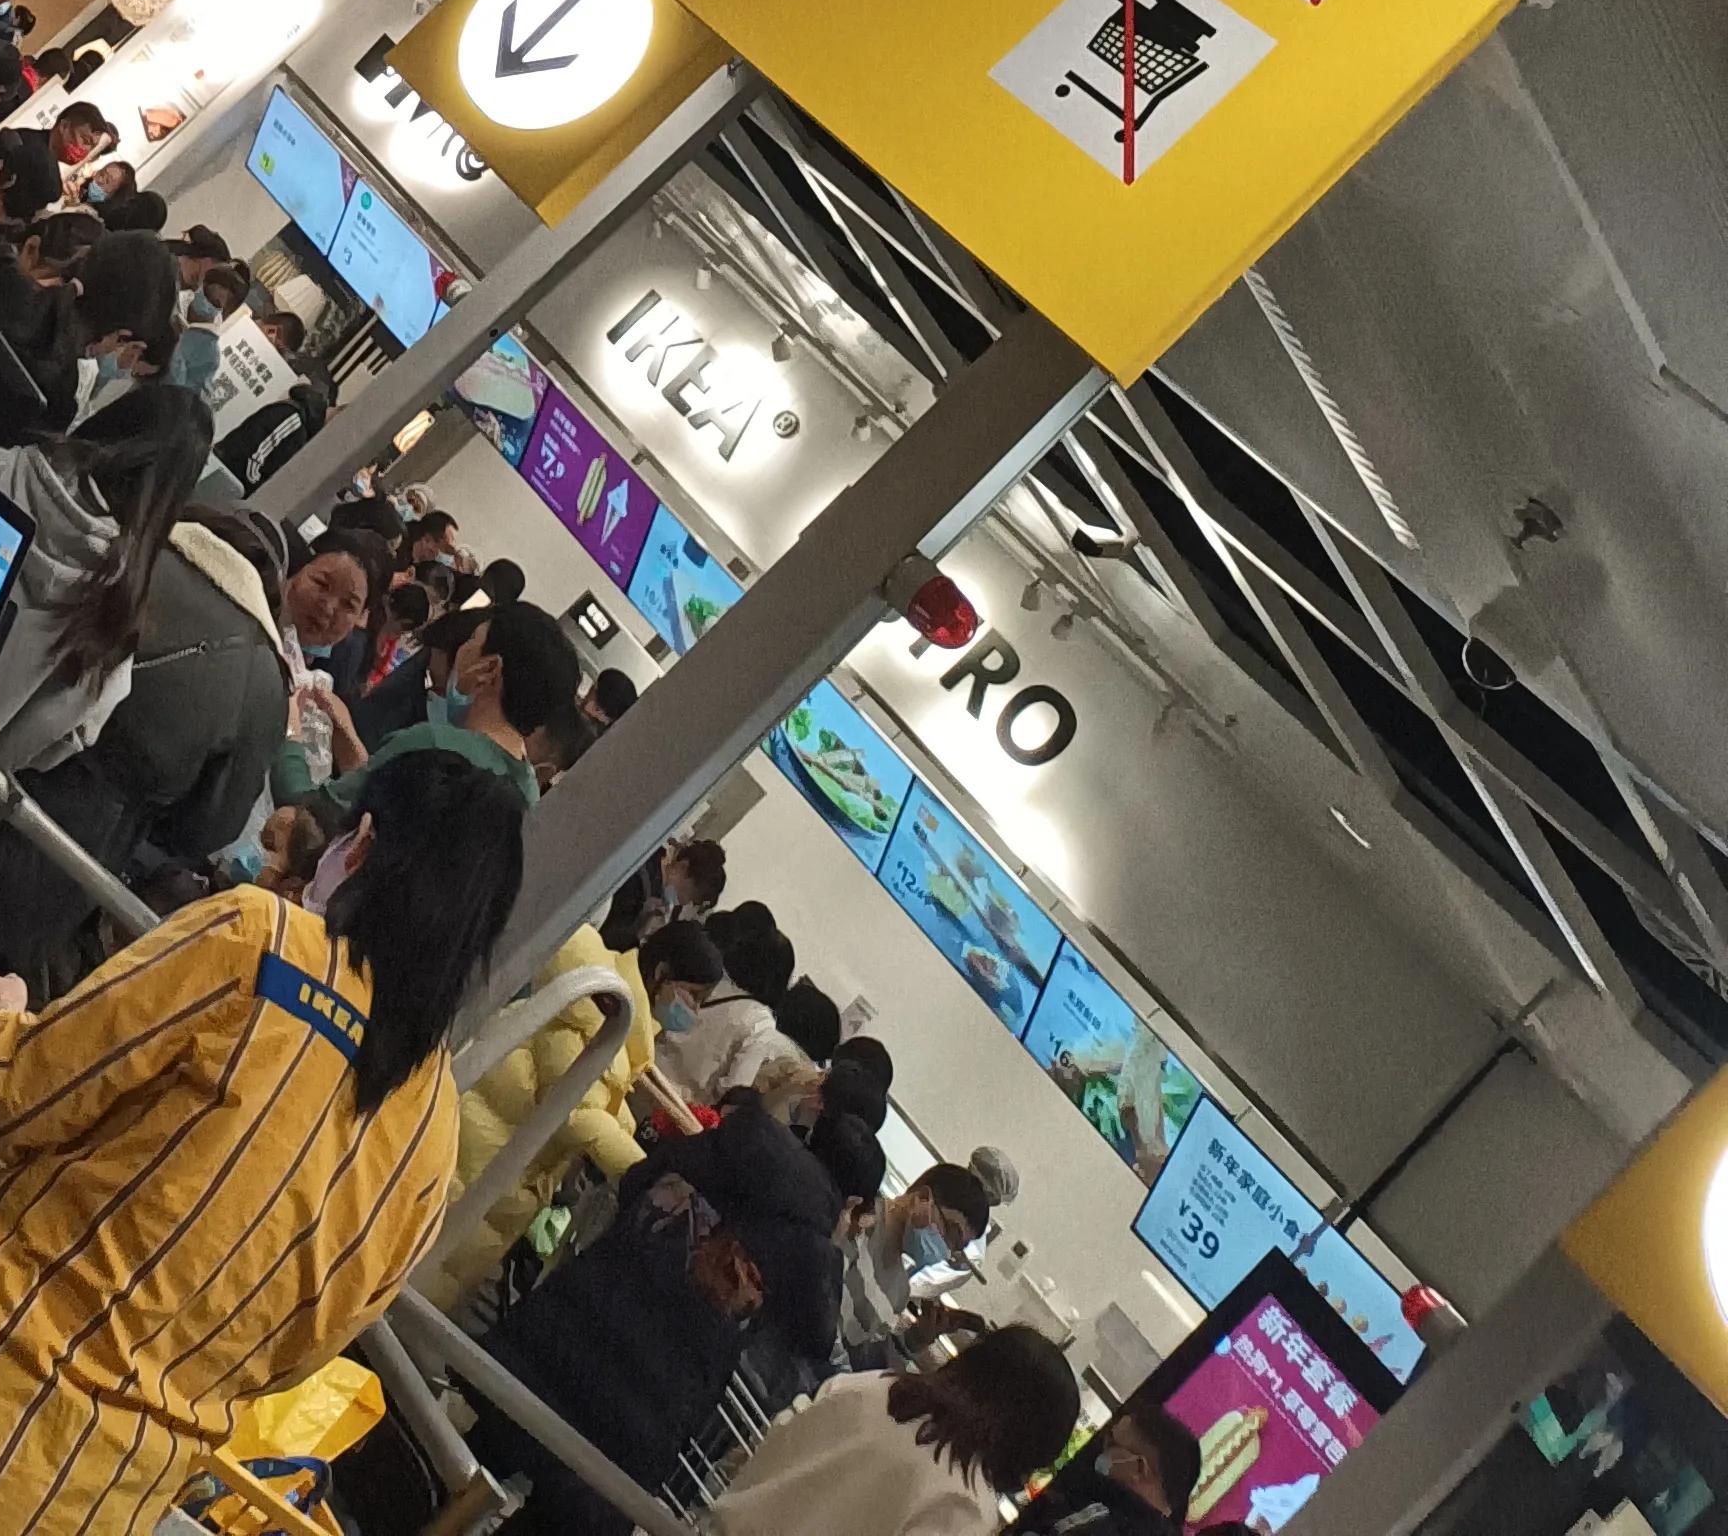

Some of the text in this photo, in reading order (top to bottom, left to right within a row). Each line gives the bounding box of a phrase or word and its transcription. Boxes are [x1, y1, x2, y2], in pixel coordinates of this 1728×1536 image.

[606, 289, 762, 463] IKEA
[296, 980, 365, 1048] IKEA
[1179, 1197, 1220, 1261] ¥39
[1206, 1137, 1322, 1257] 新年家庭小食
[1252, 1302, 1361, 1420] 新年套餐
